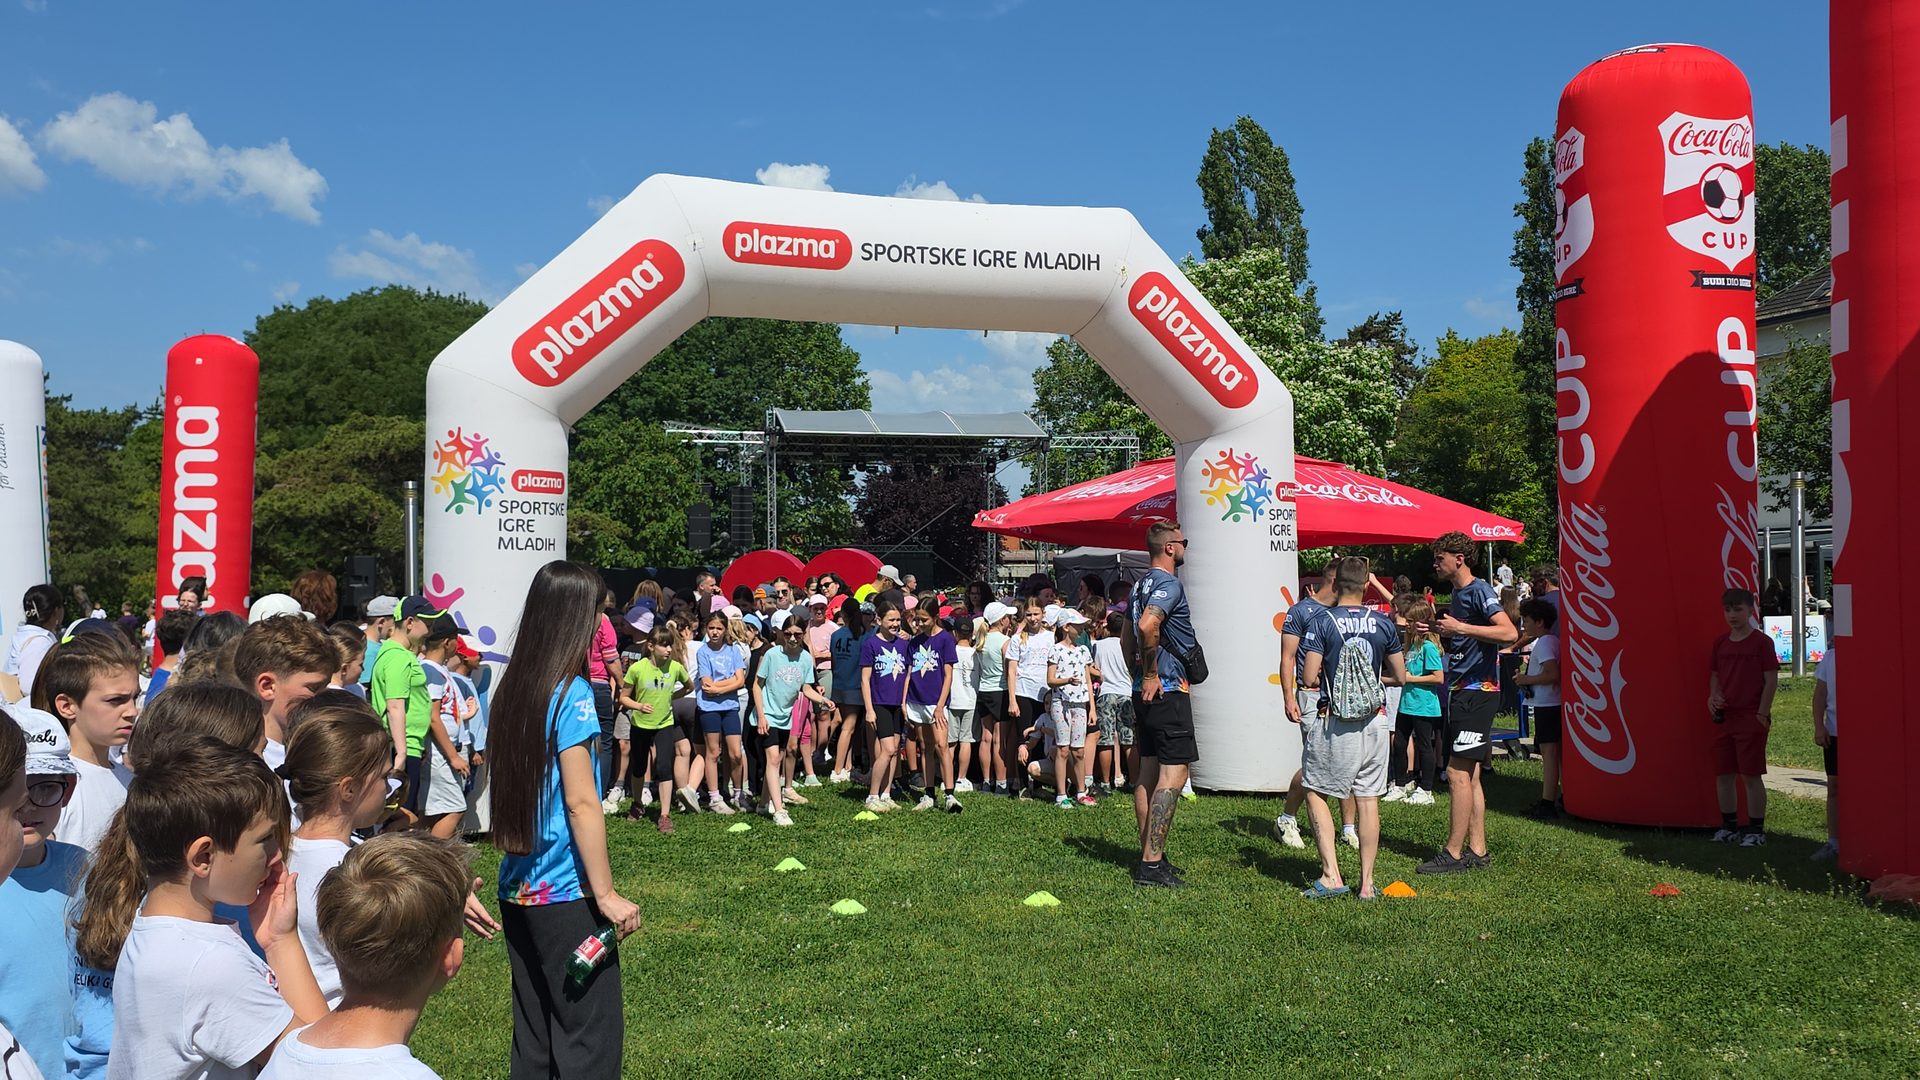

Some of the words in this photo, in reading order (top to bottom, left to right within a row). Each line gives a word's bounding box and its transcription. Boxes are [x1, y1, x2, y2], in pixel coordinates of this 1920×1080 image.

[1668, 121, 1751, 158] Coca-Cola
[735, 228, 835, 259] plazma
[860, 242, 967, 267] SPORTSKE
[973, 249, 1017, 269] IGRE
[1024, 251, 1101, 271] MLADIH
[1702, 231, 1748, 250] CUP
[1702, 277, 1725, 286] BUDI
[1726, 277, 1739, 286] DIO
[529, 259, 664, 379] plazma
[1135, 285, 1243, 391] plazma
[1556, 326, 1596, 485] CUP
[1716, 316, 1758, 483] CUP
[517, 472, 563, 490] plazma
[1295, 480, 1418, 509] oca-Cola
[499, 500, 565, 516] SPORTSKE
[499, 518, 535, 533] IGRE
[1270, 524, 1292, 537] IGRE
[498, 536, 556, 551] MLADIH
[1556, 490, 1637, 776] Coca-Cola
[1457, 731, 1484, 744] NIKE
